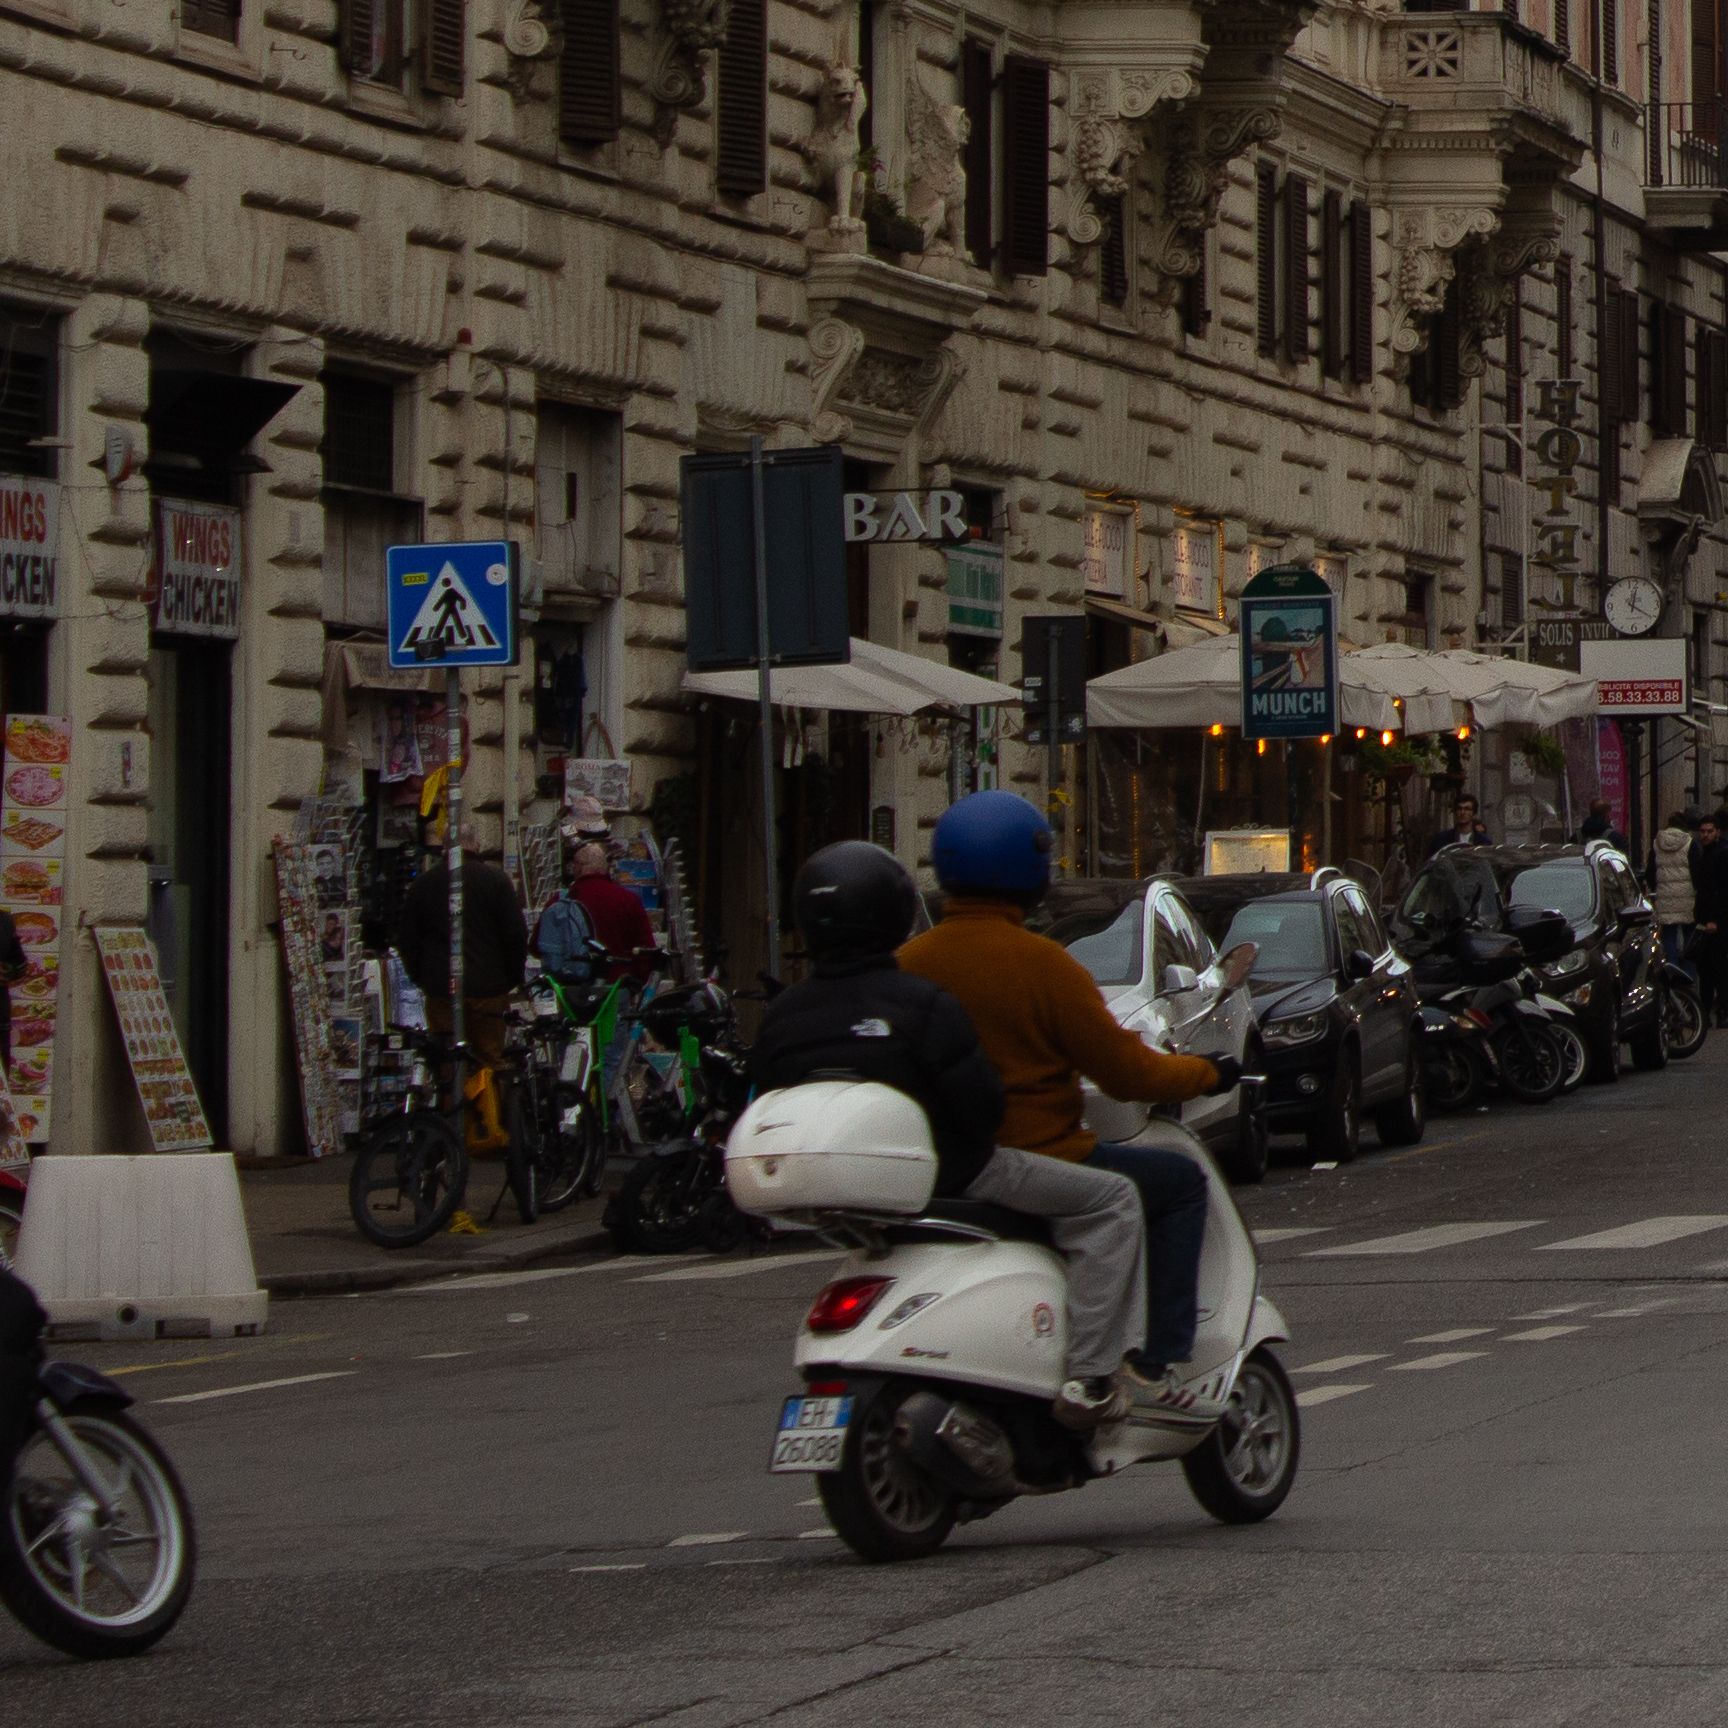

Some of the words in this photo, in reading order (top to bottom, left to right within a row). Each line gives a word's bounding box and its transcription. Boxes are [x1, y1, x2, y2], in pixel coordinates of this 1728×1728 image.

[843, 492, 967, 541] BAR
[173, 512, 231, 567] WINGS
[165, 573, 239, 626] CHICKEN
[1539, 623, 1573, 646] SOLIS
[1252, 691, 1326, 715] MUNCH
[799, 1400, 829, 1426] EH
[776, 1435, 840, 1463] 26088
